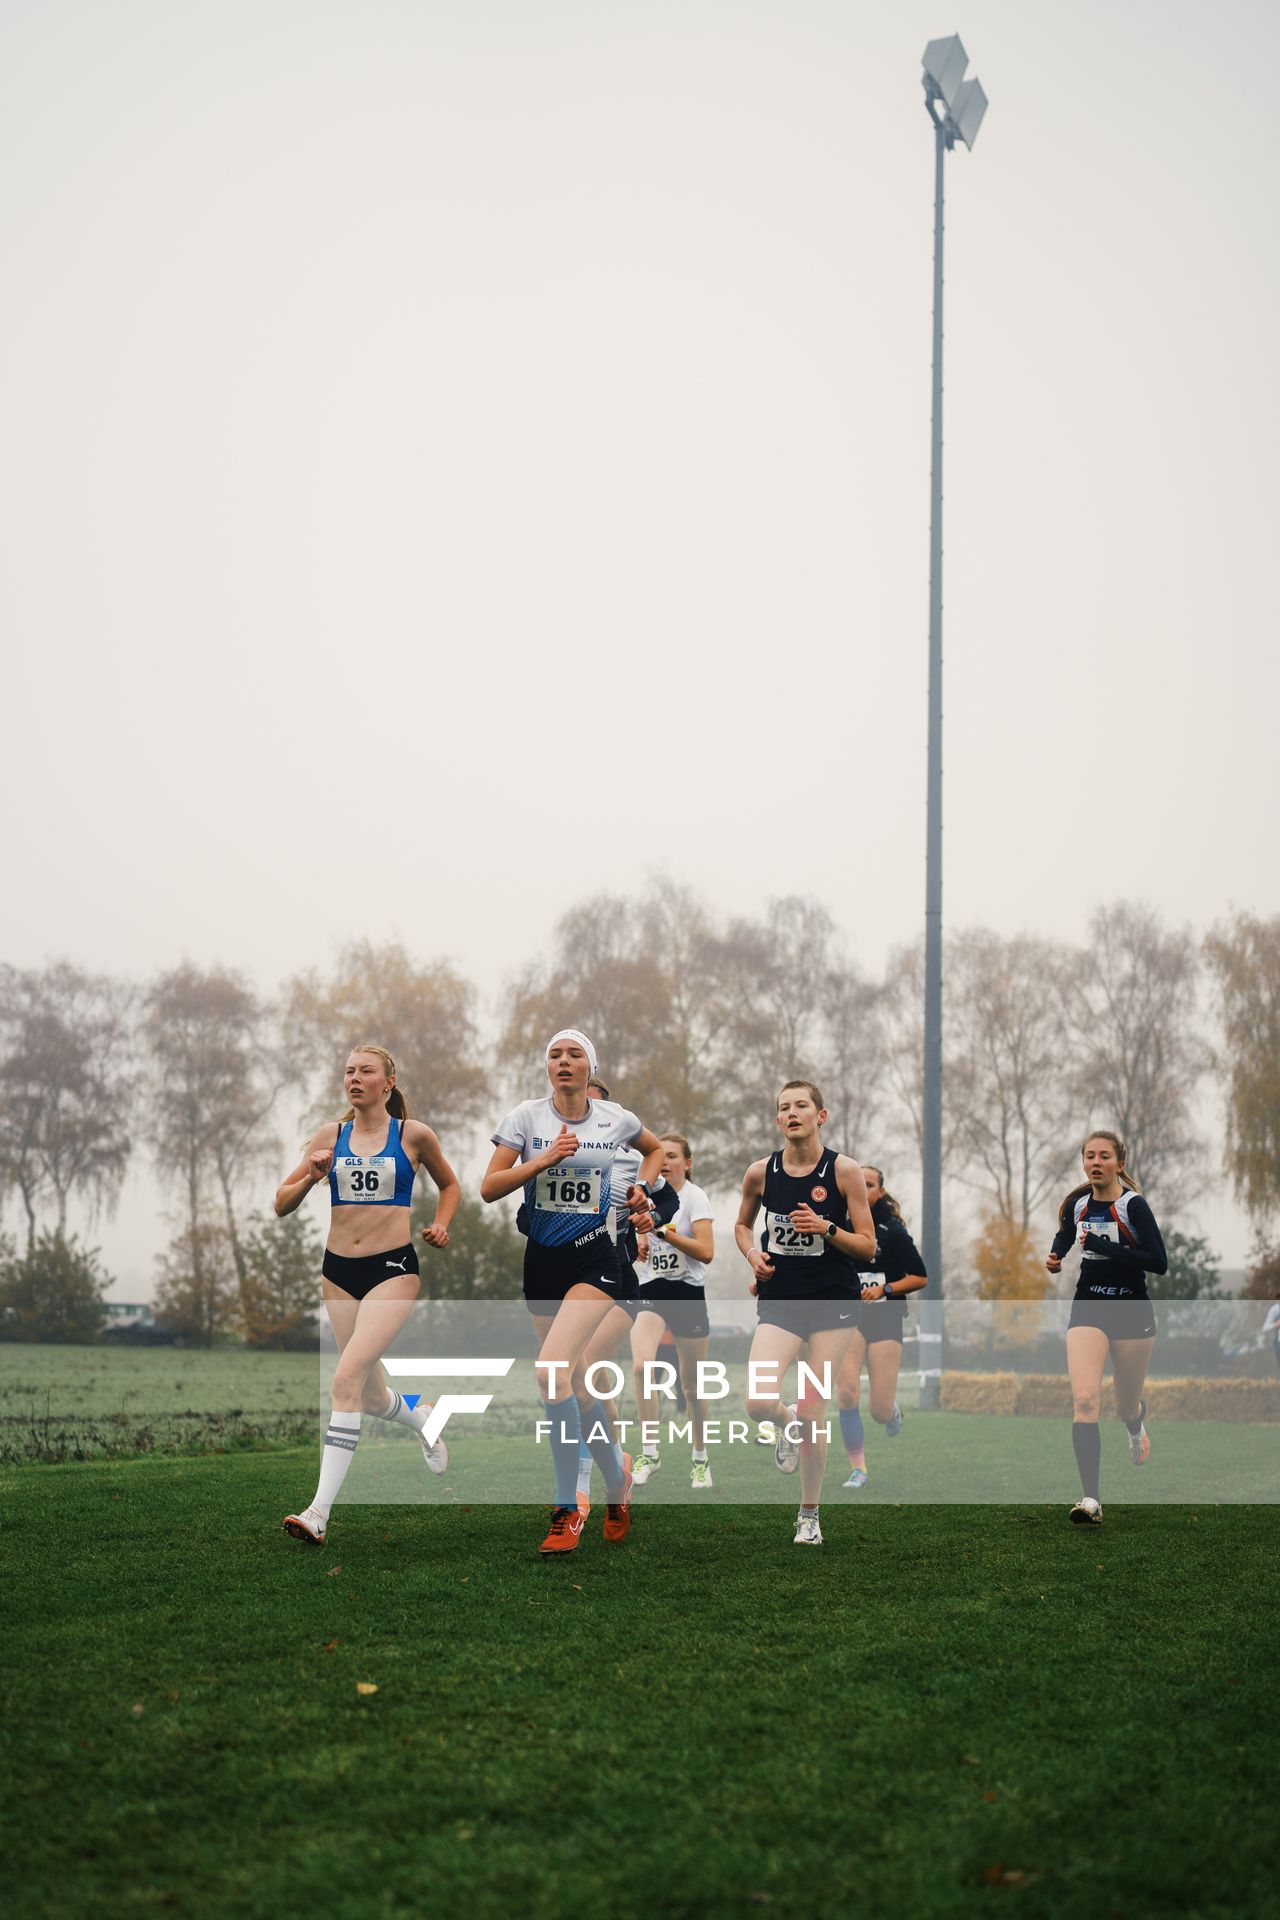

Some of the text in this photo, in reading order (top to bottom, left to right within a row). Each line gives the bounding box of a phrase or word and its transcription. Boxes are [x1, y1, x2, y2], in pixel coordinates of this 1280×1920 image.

[345, 1158, 363, 1166] GLS
[547, 1168, 567, 1177] GLS
[350, 1170, 380, 1192] 36
[546, 1180, 591, 1204] 168
[774, 1215, 791, 1223] GLS
[574, 1232, 595, 1248] NIKE
[652, 1253, 680, 1271] 952
